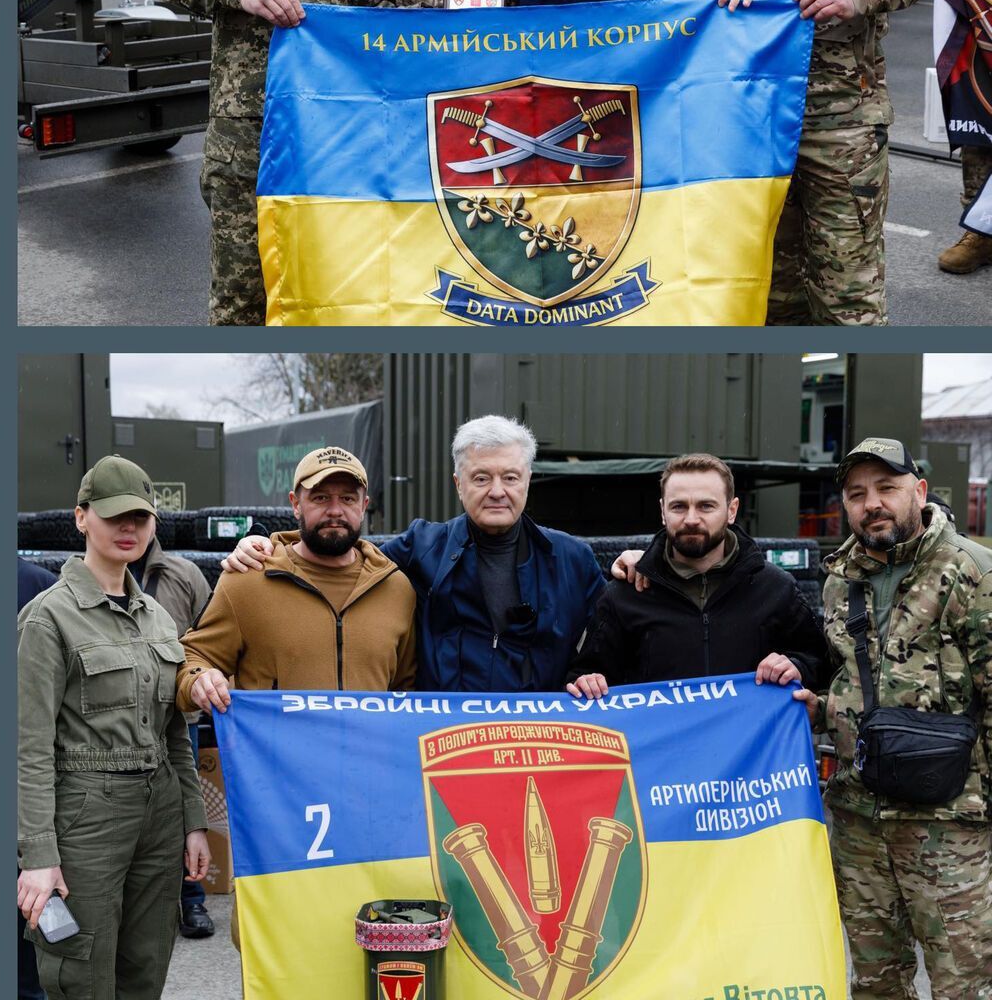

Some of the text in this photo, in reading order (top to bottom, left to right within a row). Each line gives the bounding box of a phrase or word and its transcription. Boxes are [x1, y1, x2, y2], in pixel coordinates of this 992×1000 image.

[361, 17, 697, 53] 14 АРМІЙСЬКИЙ КОРПУС
[466, 292, 624, 325] DATA DOMINANT
[281, 679, 738, 714] ЗБРОЙНІ СИЛИ УКРАЇНИ
[488, 725, 583, 743] НАРОДЖУЮТЬСЯ
[584, 729, 622, 750] ВОЇНИ
[493, 749, 519, 765] АРТ.
[537, 749, 565, 766] ДИВ.
[650, 763, 812, 807] АРТИЛЕРІЙСЬКИЙ
[305, 803, 334, 860] 2
[695, 796, 782, 832] ДИВІЗІОН
